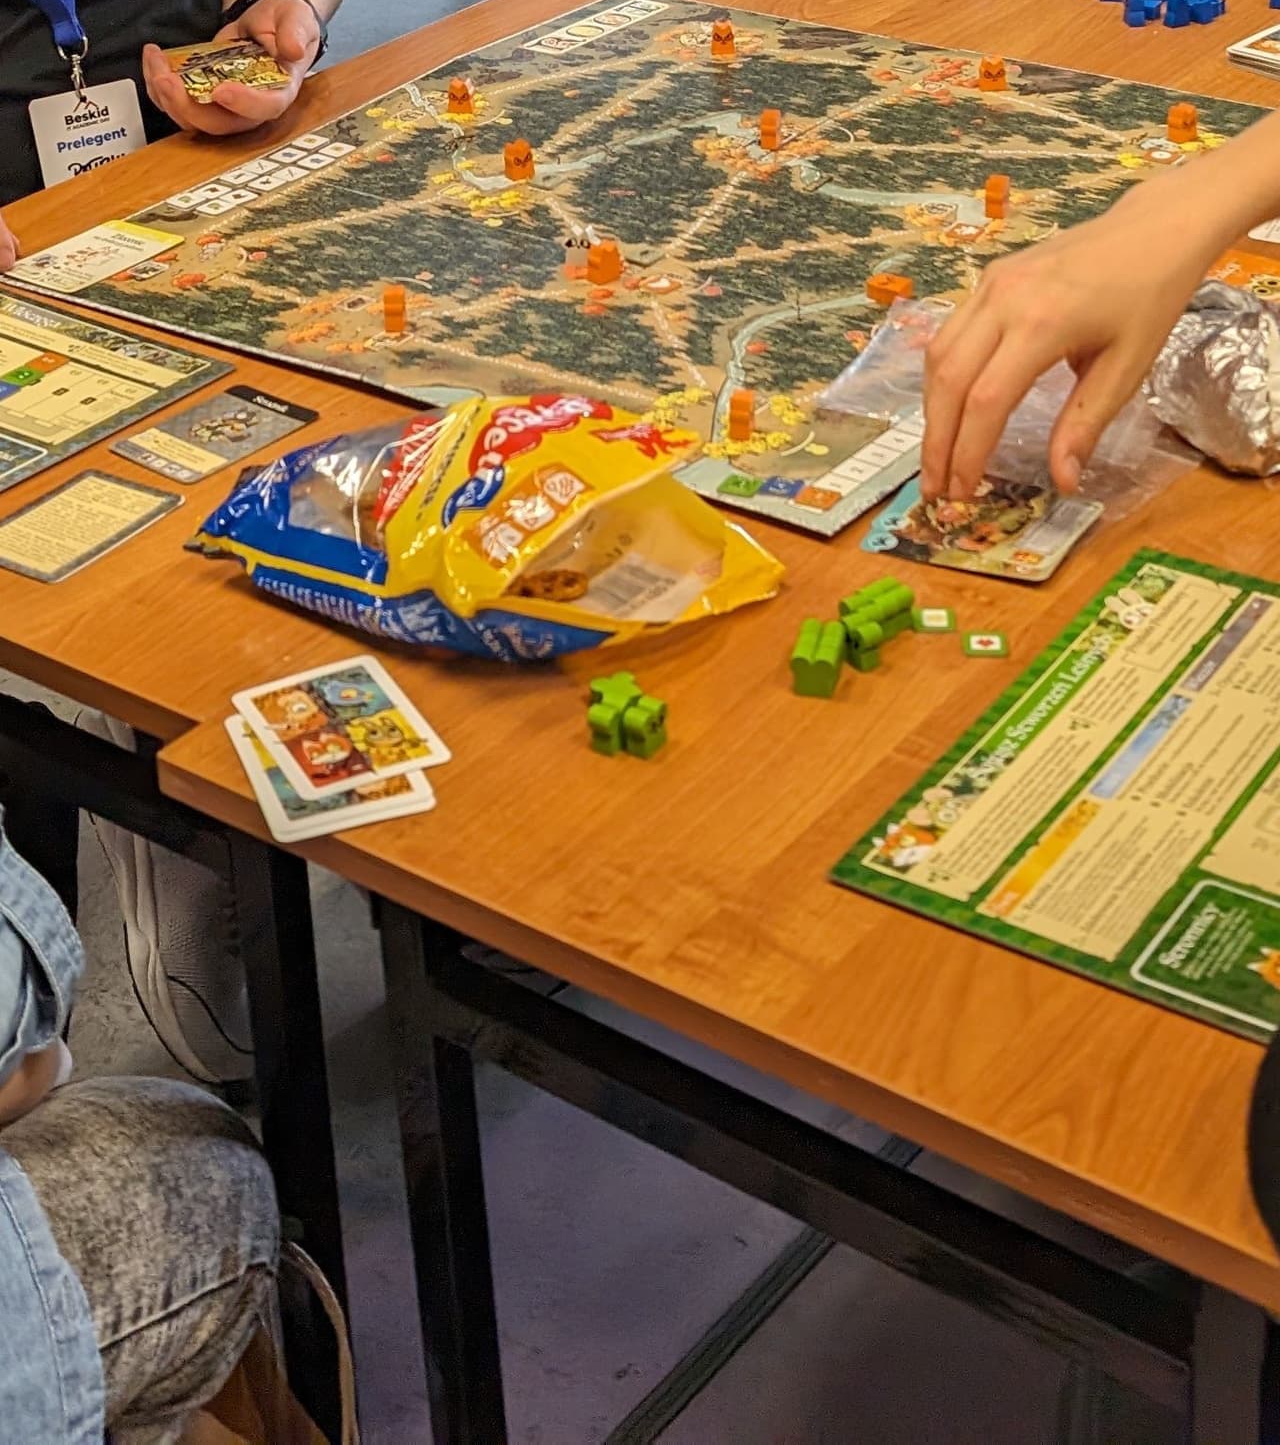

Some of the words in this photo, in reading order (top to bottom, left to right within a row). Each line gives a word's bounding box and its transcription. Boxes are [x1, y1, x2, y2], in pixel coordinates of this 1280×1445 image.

[523, 0, 663, 51] ROOT
[57, 127, 128, 154] Prelegent
[64, 105, 110, 125] Beskid
[1005, 681, 1073, 742] Stworzeń
[1158, 901, 1225, 970] Stronnicy
